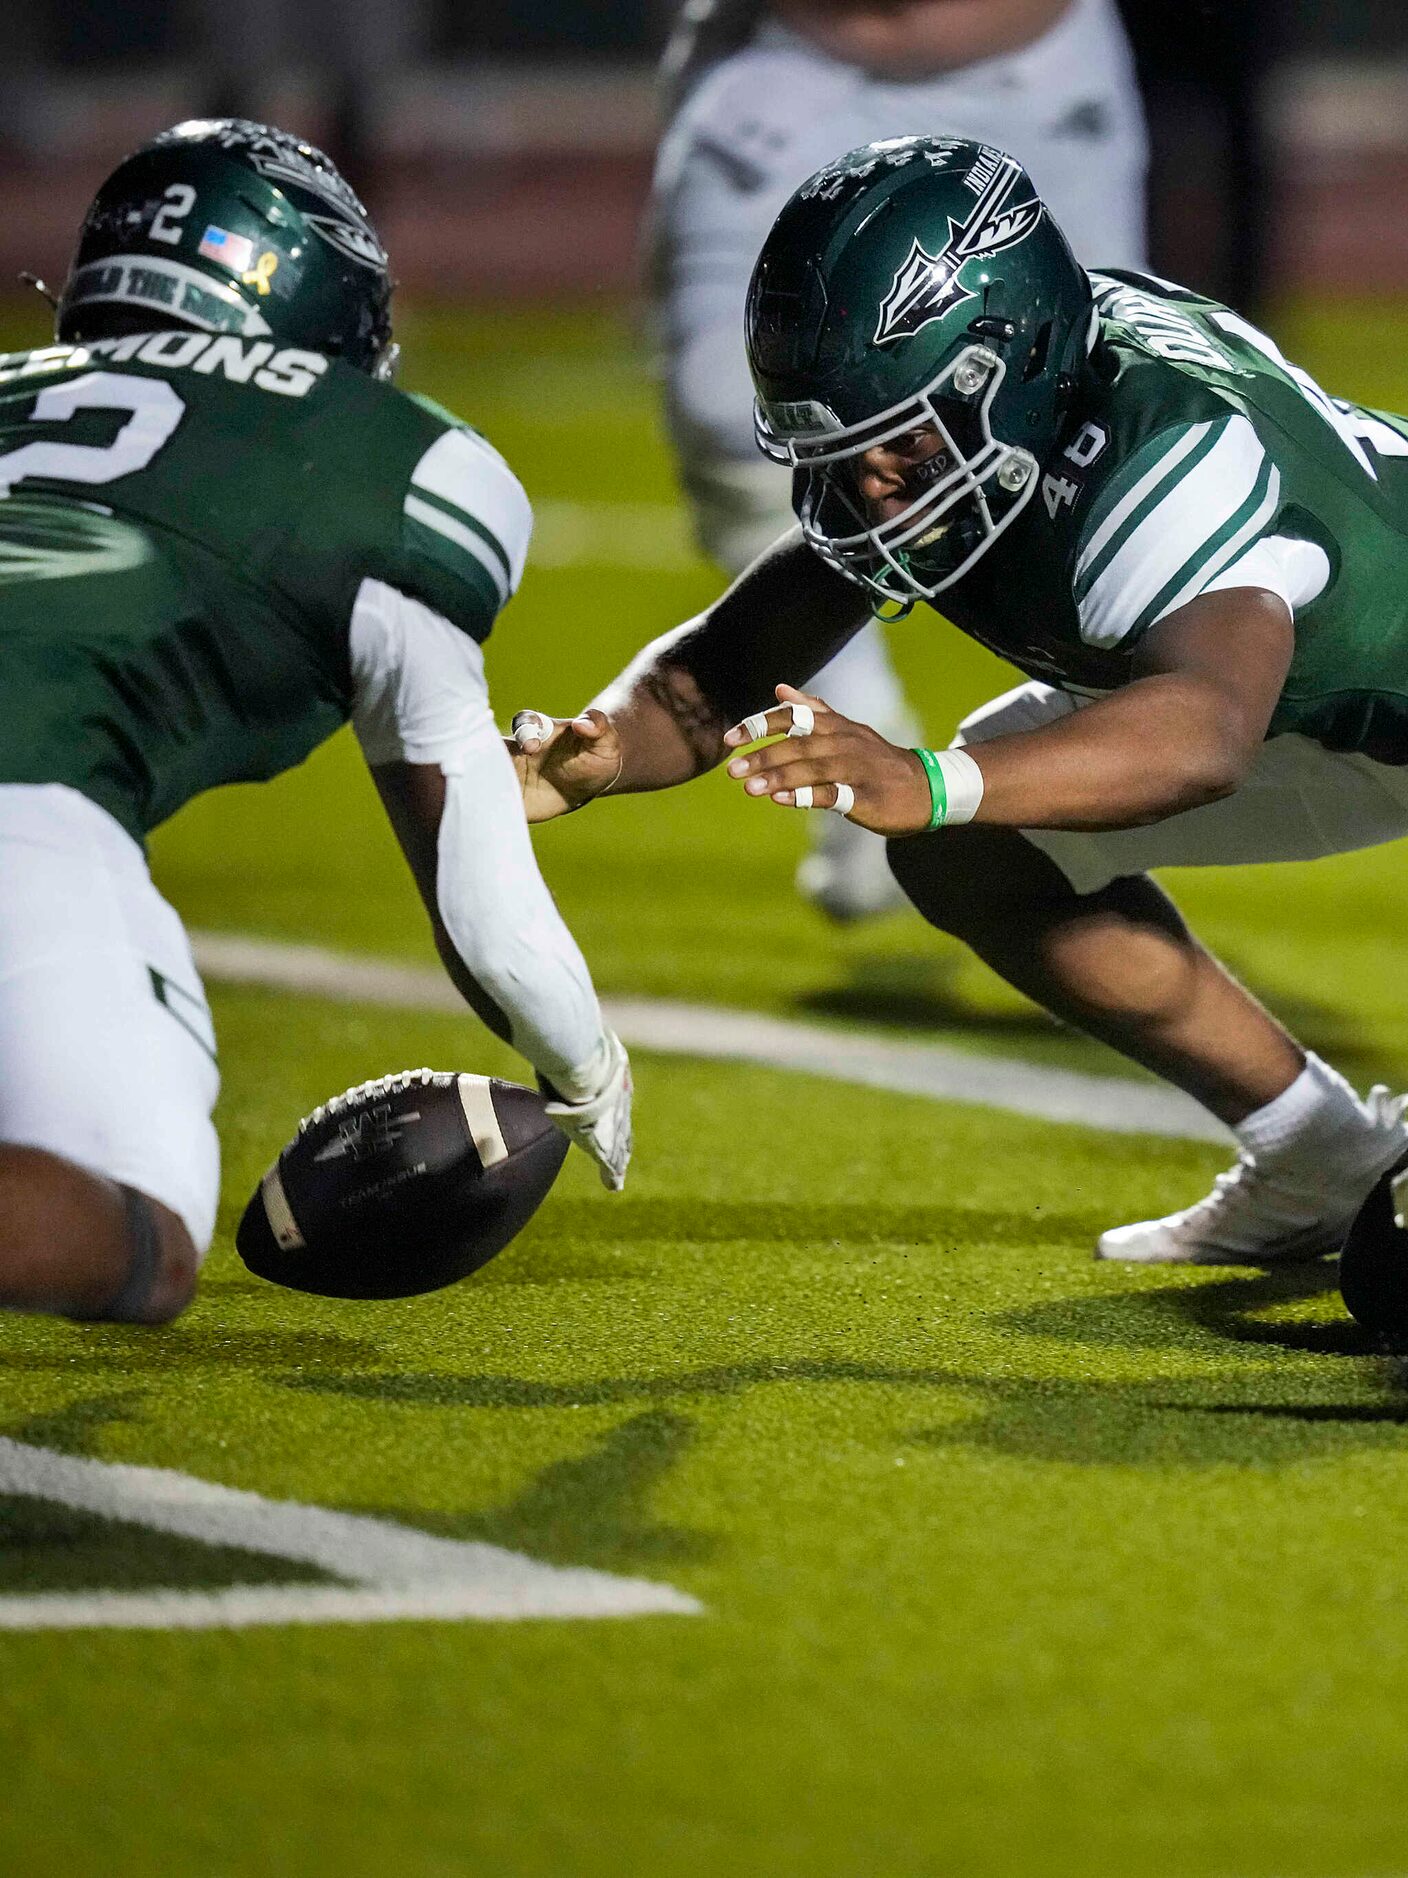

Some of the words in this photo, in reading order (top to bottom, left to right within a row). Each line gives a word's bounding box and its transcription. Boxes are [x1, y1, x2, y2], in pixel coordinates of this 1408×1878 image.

[148, 183, 197, 245] 2
[0, 370, 187, 500] 2
[1042, 421, 1106, 520] 46
